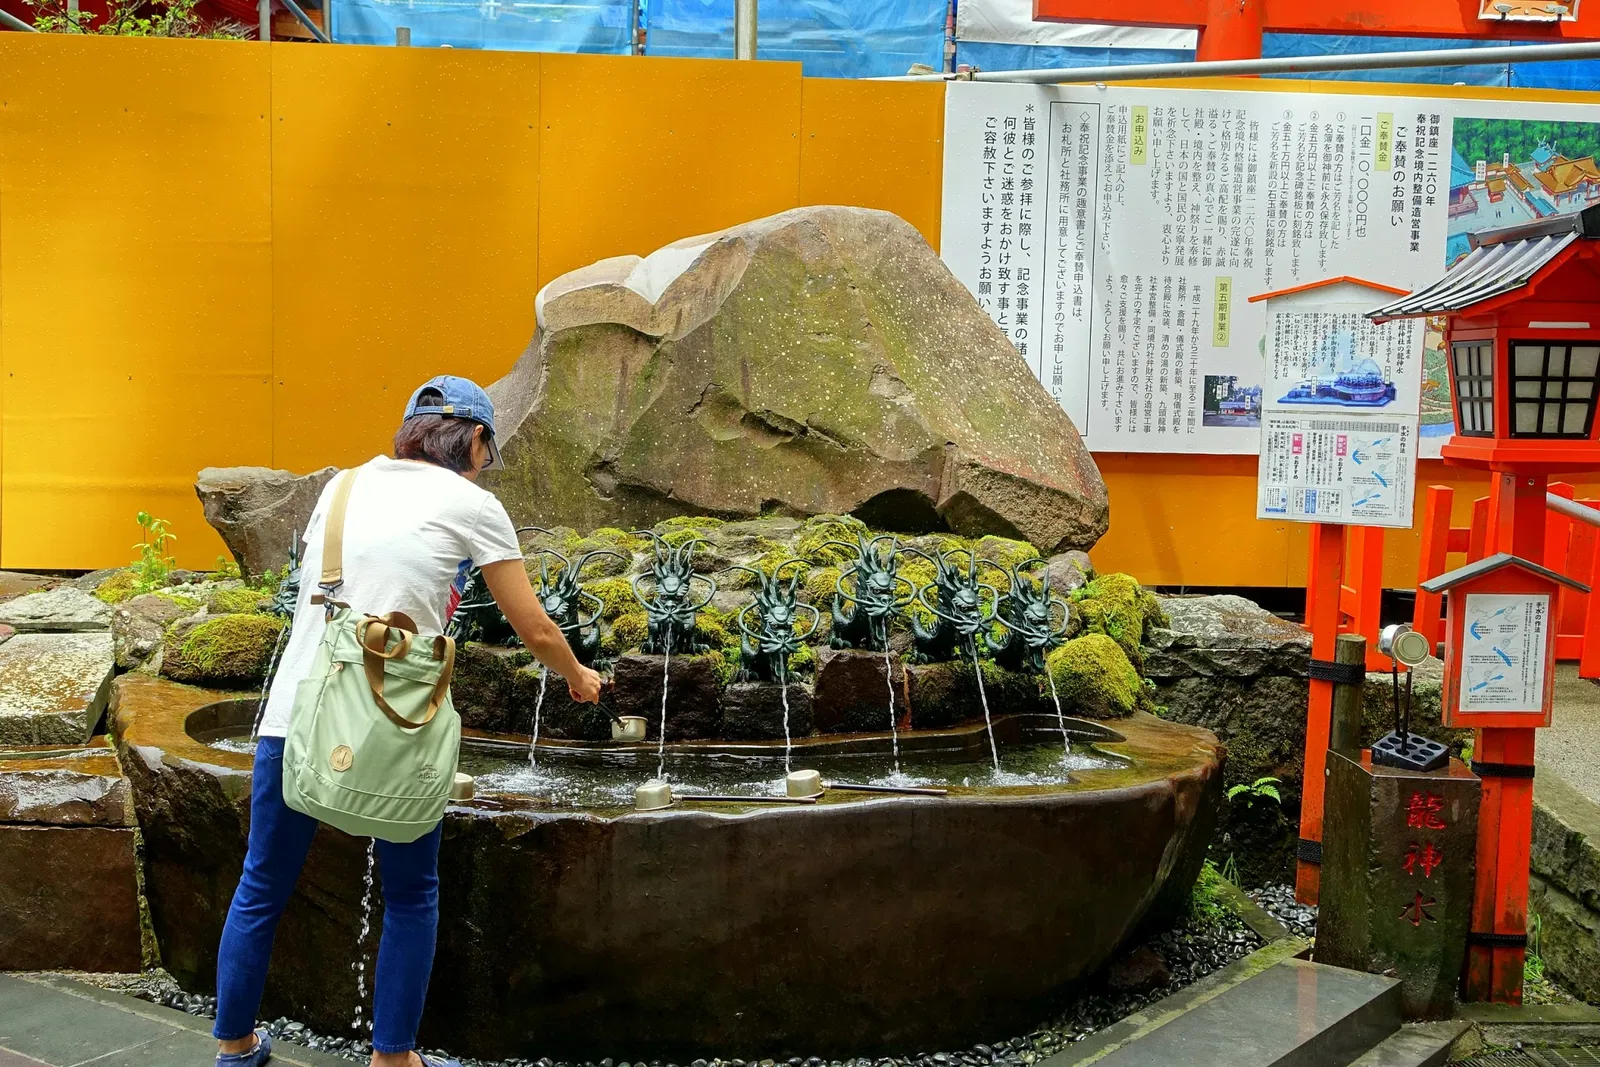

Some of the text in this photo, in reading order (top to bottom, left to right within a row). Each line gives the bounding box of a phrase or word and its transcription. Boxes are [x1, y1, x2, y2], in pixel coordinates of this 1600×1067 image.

[1115, 105, 1127, 206] 申込用紙にご記入の上、
[1134, 114, 1144, 155] お申込み
[1150, 106, 1163, 204] お願い申し上げます。
[1378, 121, 1389, 162] ご奉賛金
[1391, 126, 1408, 227] ご奉賛のお願い
[1410, 114, 1427, 252] 奉祝記念境内整備造営事業
[1425, 114, 1440, 206] 御鎮座一二六〇年
[978, 117, 998, 316] ご容赦下さいますようお願い
[1229, 109, 1246, 267] 記念境内整備造営事業の完遂に向
[1398, 790, 1446, 926] 龍神水
